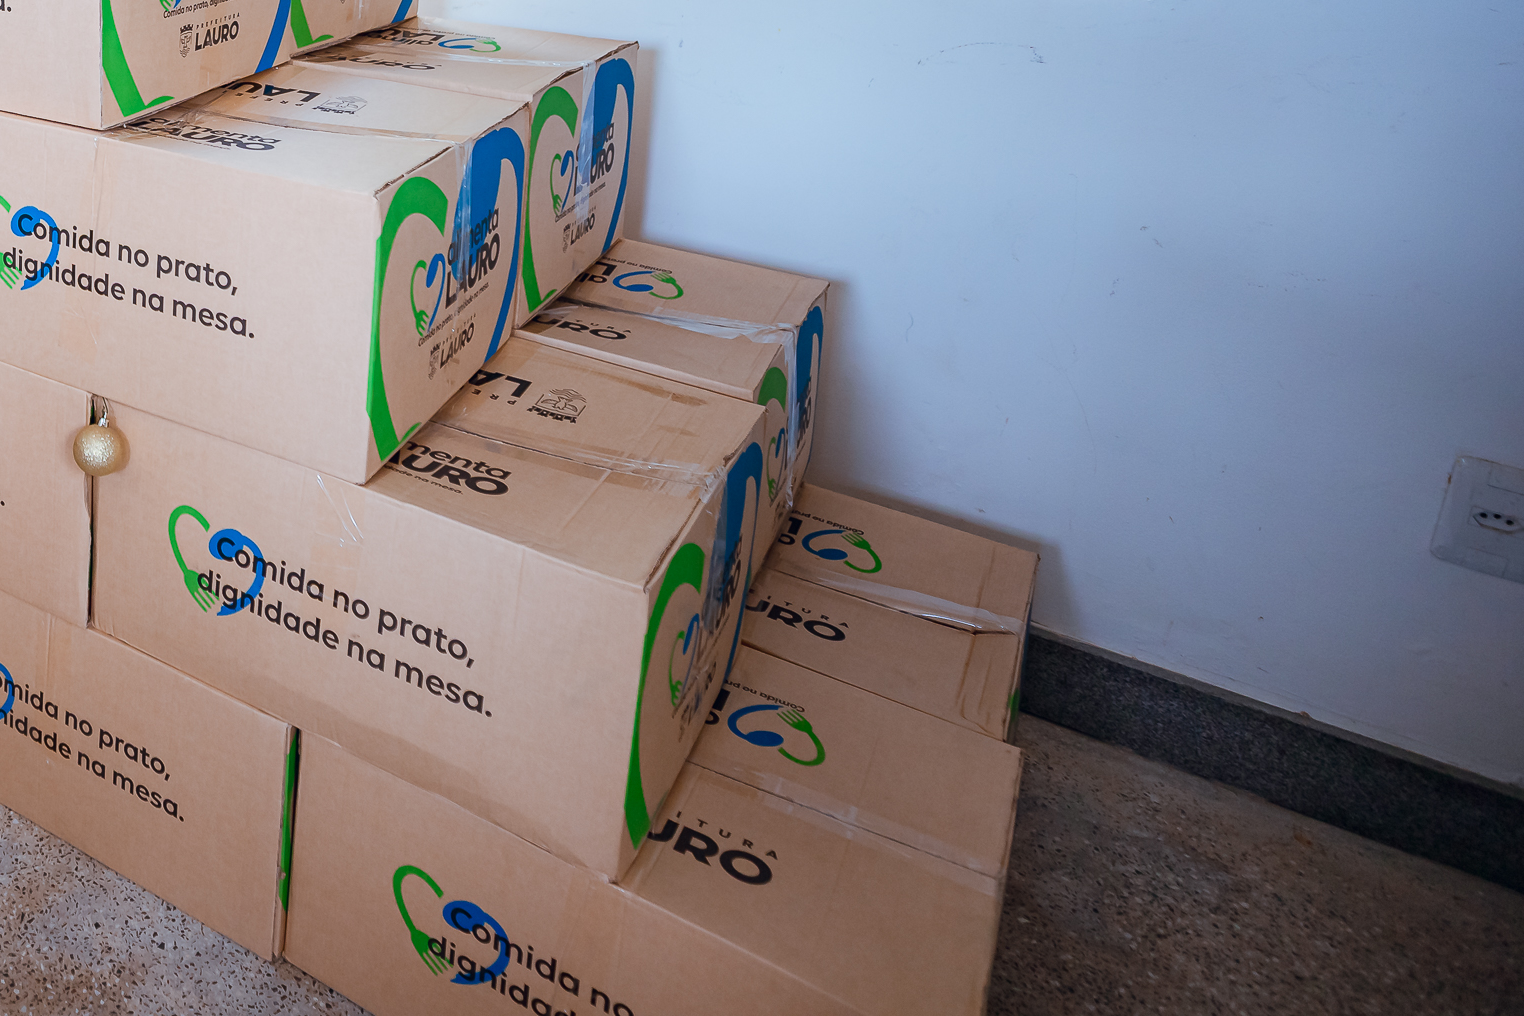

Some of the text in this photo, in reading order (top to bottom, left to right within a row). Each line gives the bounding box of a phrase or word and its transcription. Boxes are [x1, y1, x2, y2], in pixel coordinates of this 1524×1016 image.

[164, 6, 184, 19] Comida
[186, 4, 192, 12] no
[195, 20, 239, 51] LAURO
[3, 247, 255, 338] dignidade na mesa.
[18, 214, 237, 296] Comida no prato,
[440, 322, 474, 369] LAURO
[217, 537, 474, 668] Comida no prato,
[198, 569, 492, 718] dignidade na mesa.
[65, 710, 92, 736] no
[99, 728, 170, 781] prato,
[78, 751, 105, 779] na
[113, 770, 184, 822] mesa.
[451, 908, 580, 997] Comida
